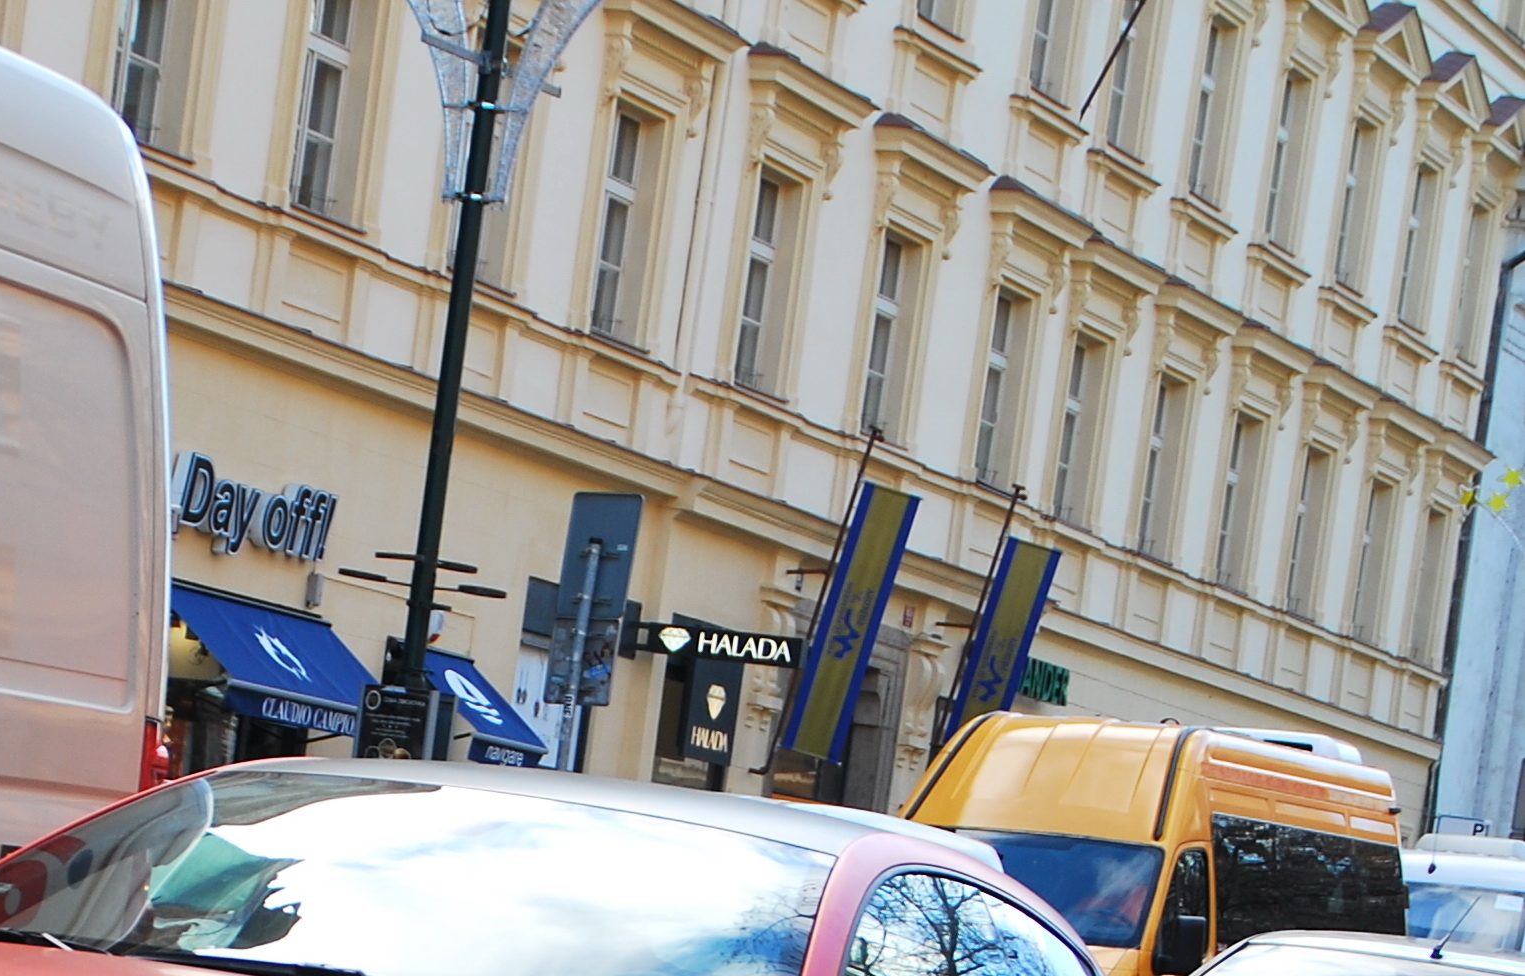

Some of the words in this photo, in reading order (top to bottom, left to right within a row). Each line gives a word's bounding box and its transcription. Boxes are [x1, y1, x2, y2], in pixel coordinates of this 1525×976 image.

[178, 452, 265, 556] Day
[262, 484, 340, 562] off!
[697, 631, 791, 663] HALADA
[262, 697, 312, 725] CLAUDIO
[312, 708, 356, 735] CAMPIO
[690, 725, 728, 753] HALADA
